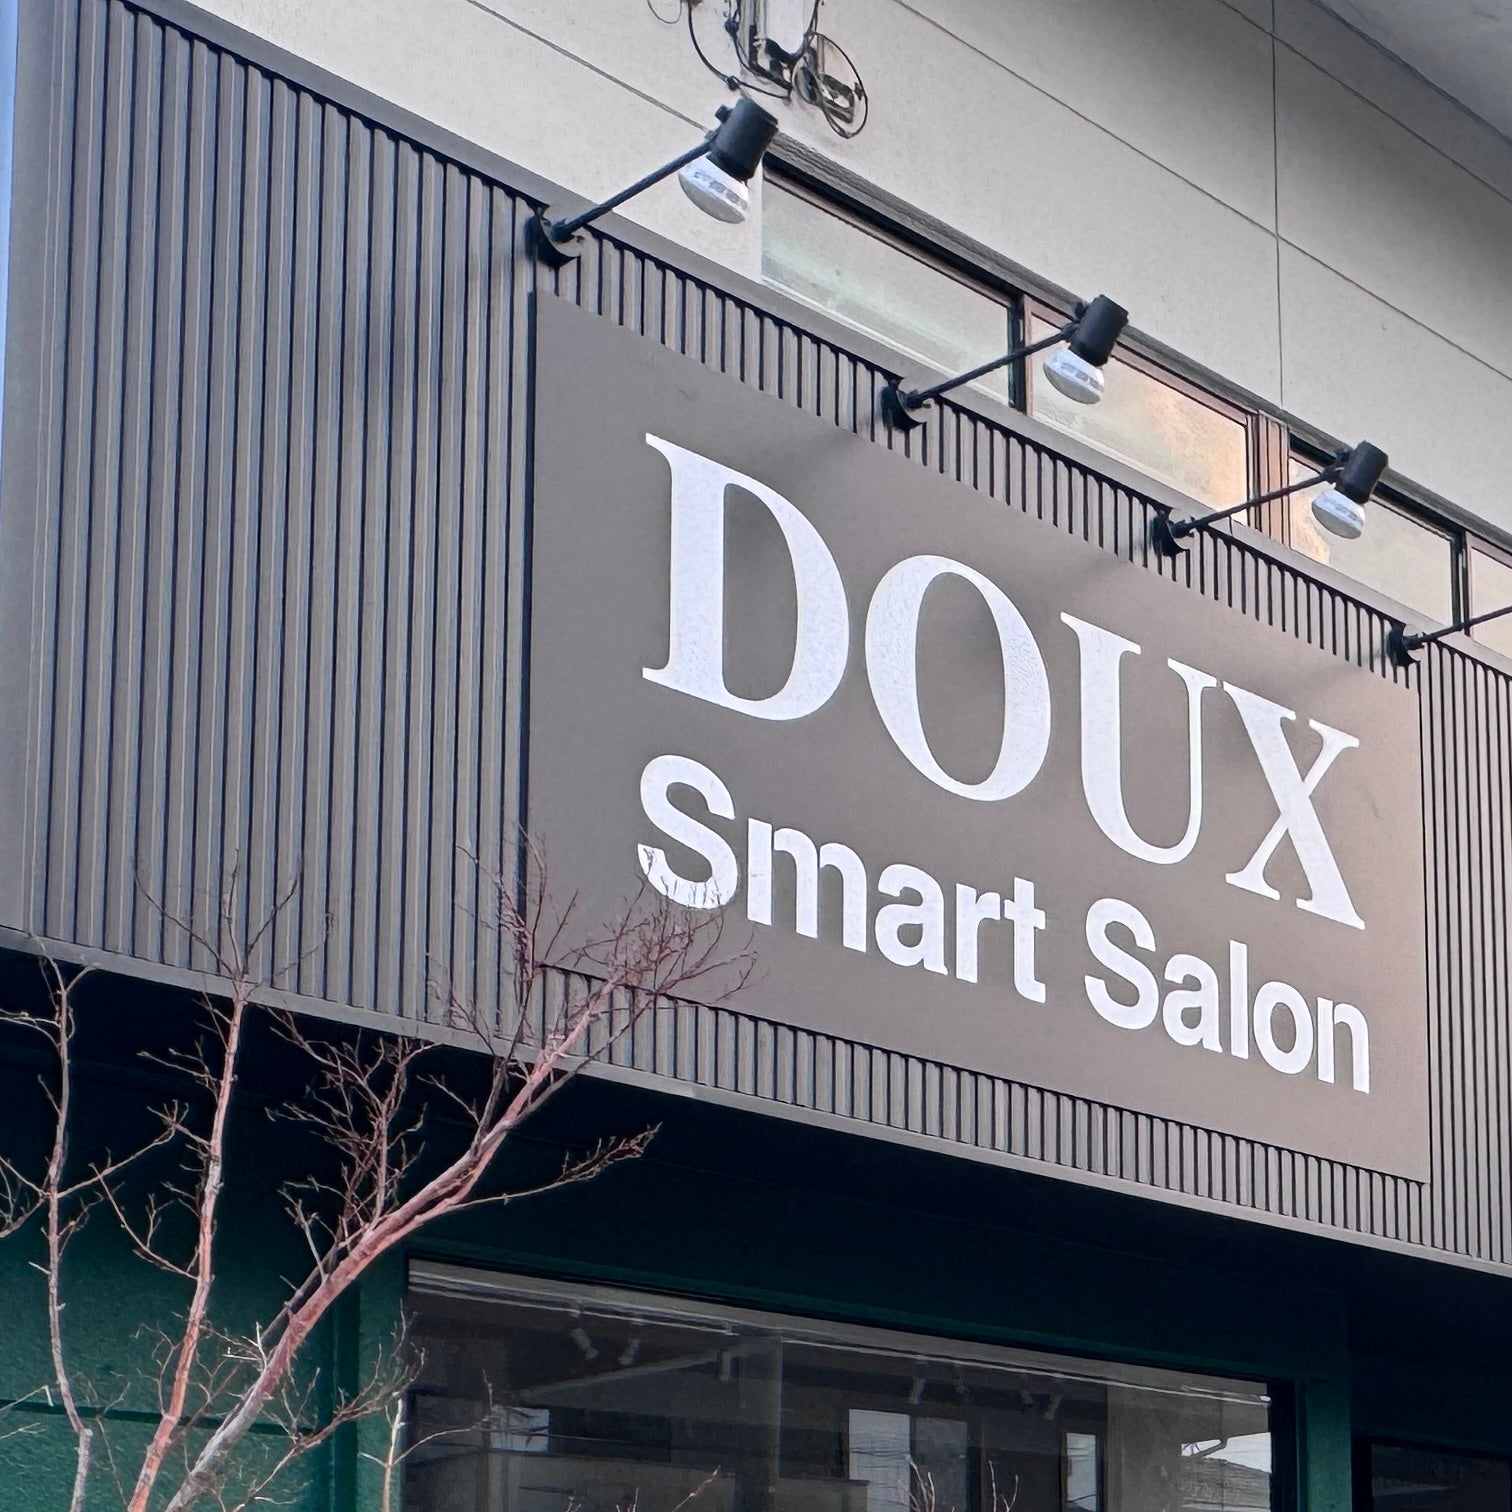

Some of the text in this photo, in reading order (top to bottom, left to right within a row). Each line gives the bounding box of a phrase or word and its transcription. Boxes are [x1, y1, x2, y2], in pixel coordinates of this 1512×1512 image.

[642, 433, 1365, 930] DOUX
[637, 754, 1370, 1093] Smart Salon
